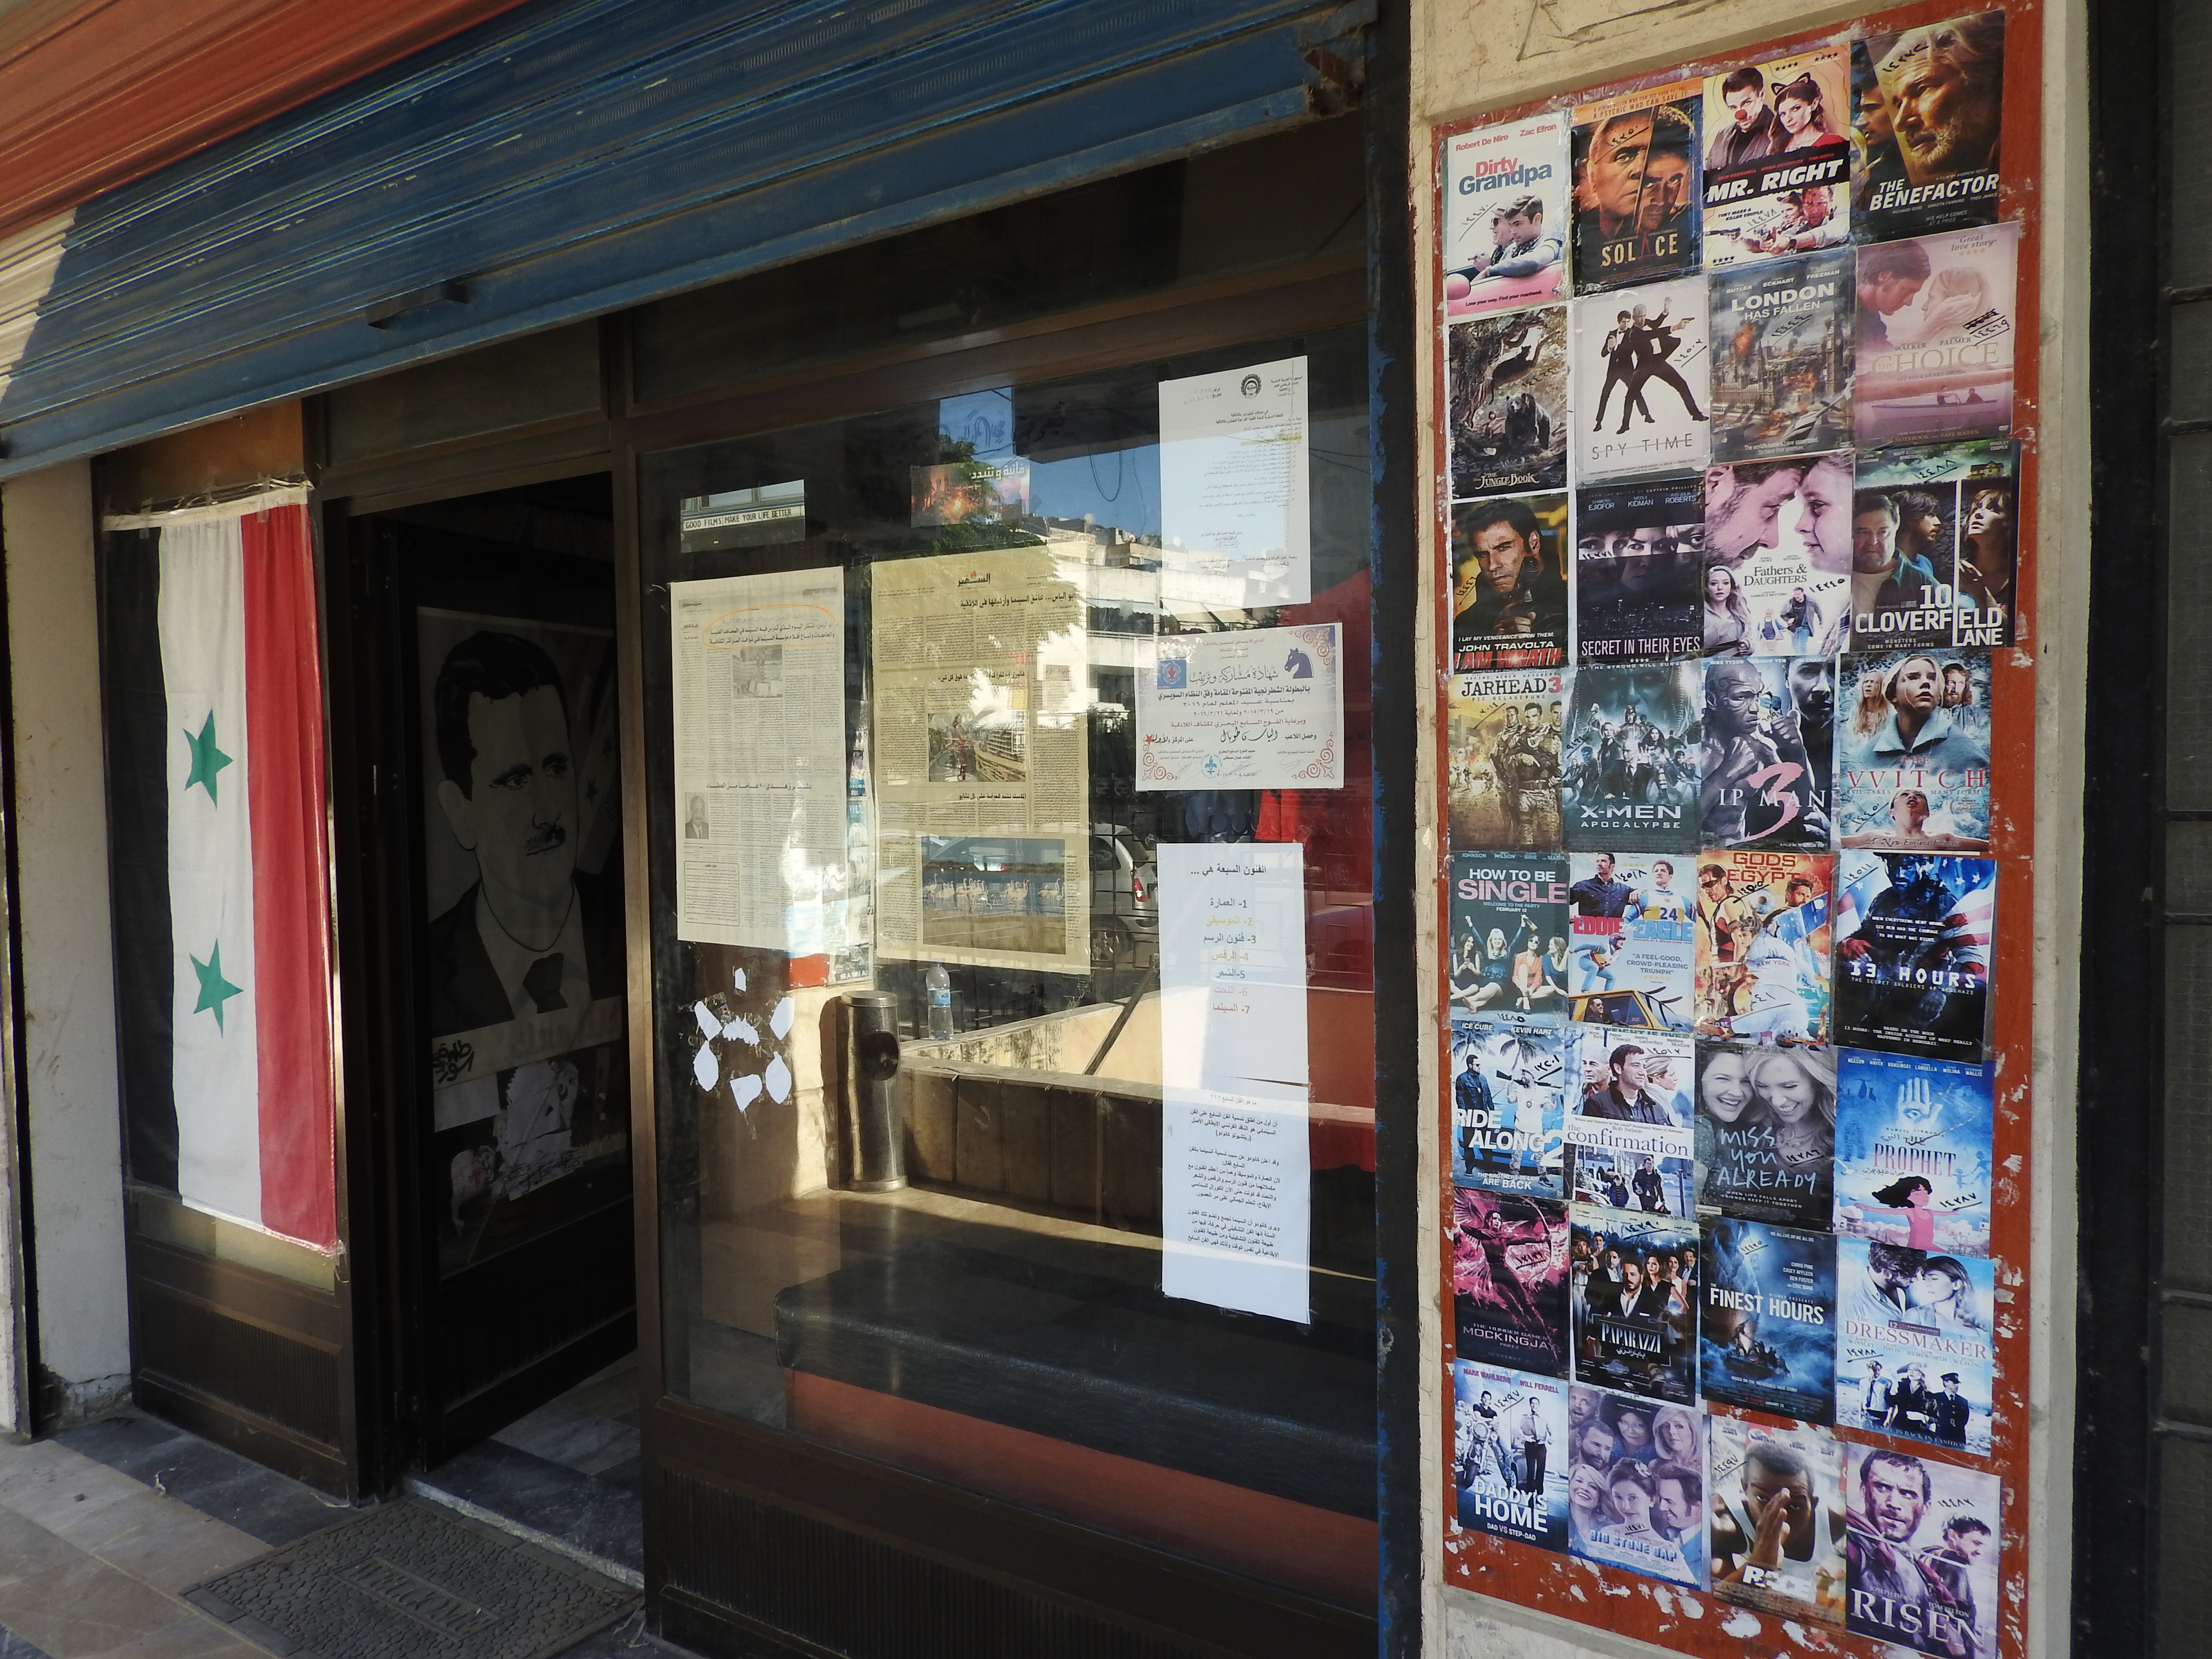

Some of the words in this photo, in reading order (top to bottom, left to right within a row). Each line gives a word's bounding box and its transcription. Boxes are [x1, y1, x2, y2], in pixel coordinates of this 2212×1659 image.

[1456, 140, 1480, 151] Robert
[1493, 134, 1508, 143] Niro
[1537, 124, 1556, 133] Efron
[1476, 156, 1518, 178] Dirty
[1459, 164, 1552, 195] Grandpa
[1707, 179, 1754, 203] MR.
[1760, 159, 1843, 192] RIGHT
[1879, 178, 1905, 193] THE
[1869, 173, 1999, 212] BENEFACTOR
[1601, 233, 1678, 267] SOLACE
[1763, 277, 1795, 288] ECKHART
[1806, 270, 1840, 279] FREEMAN
[1731, 282, 1835, 312] LONDON
[1744, 309, 1770, 321] HAS
[1773, 301, 1821, 316] FALLEN
[1940, 337, 1972, 346] PALMER
[1874, 342, 1999, 373] CHOICE
[1592, 443, 1627, 459] SPY
[1642, 433, 1692, 452] TIME
[1003, 462, 1025, 475] فانية
[1474, 474, 1510, 490] JUNGLE
[1509, 472, 1540, 487] BOOK
[1588, 503, 1615, 511] EJIOFOR
[1665, 495, 1696, 504] ROBERTS
[685, 520, 701, 529] GOOD
[704, 517, 721, 527] FILMS
[724, 515, 740, 524] MAKE
[742, 513, 756, 522] YOUR
[758, 510, 769, 520] LIFE
[771, 508, 792, 517] BETTER
[1754, 565, 1793, 577] Fathers
[1796, 564, 1807, 574] &
[957, 572, 991, 587] السفير
[1743, 575, 1807, 586] DAUGHTERS
[960, 599, 978, 610] اللاذقية
[1011, 595, 1029, 605] السينما
[1920, 584, 1952, 610] 10
[1855, 607, 2003, 634] CLOVERFIELD
[1582, 639, 1621, 656] SECRET
[1624, 639, 1635, 654] IN
[1638, 637, 1670, 653] THEIR
[1673, 636, 1700, 653] EYES
[1952, 628, 2003, 647] LANE
[1459, 644, 1491, 652] JOHN
[1494, 641, 1554, 650] TRAVOLTA
[1462, 650, 1492, 670] AM
[1496, 648, 1562, 668] WRATH
[1254, 686, 1285, 695] الشطرنجية
[1286, 685, 1310, 693] بالبطولة
[1461, 678, 1547, 697] JARHEAD
[1548, 676, 1562, 694] 3
[1158, 692, 1184, 701] السويسري
[1719, 789, 1744, 806] IP
[1759, 790, 1826, 808] MAN
[1745, 761, 1804, 842] 3
[1580, 805, 1682, 819] X-MEN
[1733, 853, 1796, 867] GODS
[1202, 866, 1214, 877] هي
[1217, 864, 1240, 875] السبعة
[1244, 865, 1266, 876] الفنون
[1469, 869, 1506, 880] HOW
[1509, 870, 1531, 881] TO
[1534, 870, 1556, 882] BE
[1728, 869, 1801, 884] EGYPT
[1458, 879, 1567, 904] SINGLE
[1210, 898, 1235, 909] العمارة
[1206, 915, 1240, 926] الموسيقى
[1660, 907, 1678, 921] 24
[1574, 915, 1624, 936] EDDIE
[1633, 919, 1693, 942] EAGLE
[1203, 933, 1224, 944] الرسم
[1226, 932, 1244, 944] فنون
[1212, 950, 1237, 961] الرقص
[1626, 960, 1688, 970] CROWD-PLEASING
[1850, 961, 1876, 978] 13
[1899, 966, 1976, 989] HOURS
[1214, 986, 1235, 994] النحت
[1213, 1002, 1238, 1013] السينما
[1511, 1026, 1532, 1034] KEVIN
[1452, 1108, 1503, 1129] RIDE
[1567, 1128, 1689, 1156] confirmation
[1721, 1126, 1775, 1147] MISS
[1468, 1130, 1544, 1152] ALONG
[1540, 1130, 1564, 1167] 2
[1874, 1143, 1956, 1178] PROPHET
[1482, 1178, 1499, 1186] ARE
[1502, 1179, 1532, 1190] BACK
[1717, 1166, 1816, 1195] ALREADY
[1710, 1287, 1764, 1313] FINEST
[1769, 1298, 1824, 1325] HOURS
[1463, 1326, 1555, 1350] MOCKINGJAY
[1601, 1323, 1660, 1353] PAPARAZZI
[1845, 1320, 1987, 1359] DRESSMAKER
[1464, 1368, 1479, 1377] MARK
[1480, 1371, 1511, 1383] WAHLBERG
[1519, 1380, 1533, 1388] WILL
[1534, 1382, 1559, 1394] FERRELL
[1475, 1479, 1548, 1511] DADDY'S
[1475, 1494, 1548, 1533] HOME
[1499, 1525, 1508, 1534] VS
[1509, 1528, 1536, 1541] STEP-DAD
[1590, 1529, 1609, 1544] BIG
[1614, 1536, 1649, 1554] STONE
[1653, 1547, 1677, 1562] GAP
[1851, 1587, 1984, 1653] RISEN
